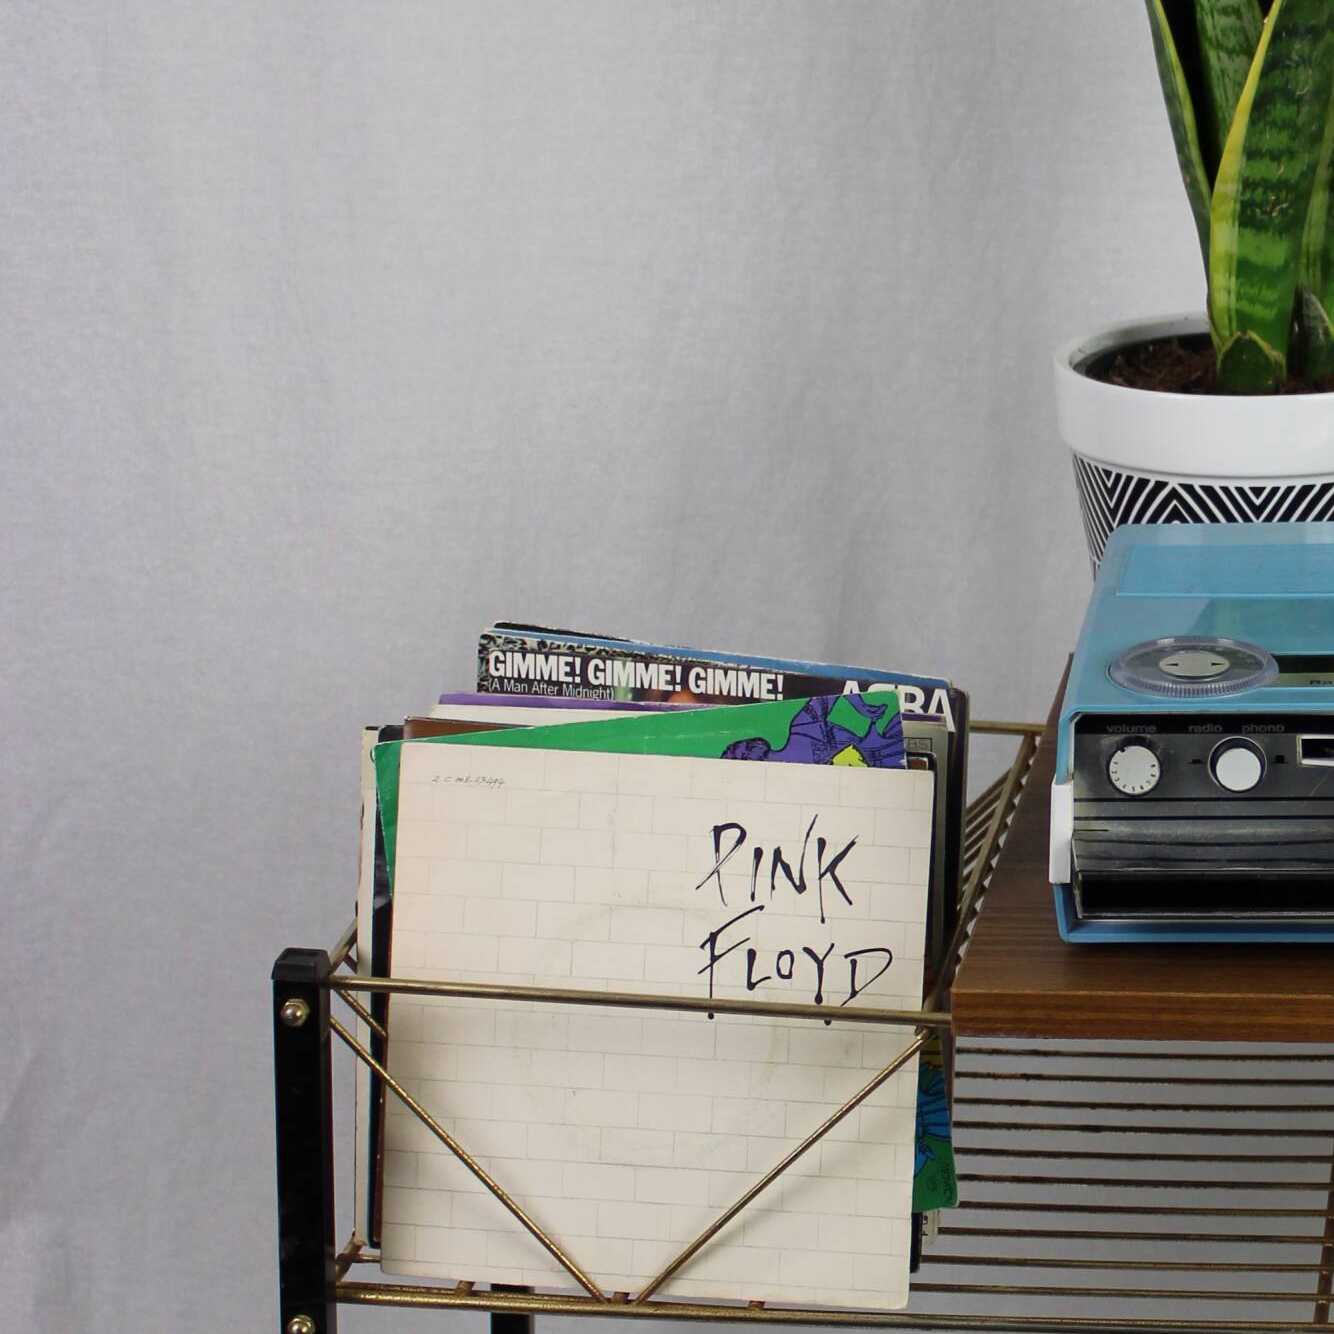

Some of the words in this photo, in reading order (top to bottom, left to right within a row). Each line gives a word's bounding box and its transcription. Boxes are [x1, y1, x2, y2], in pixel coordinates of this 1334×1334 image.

[488, 676, 501, 692] (A
[503, 680, 528, 693] Man
[532, 682, 559, 697] After
[562, 684, 615, 701] Midnight)
[489, 651, 581, 684] GIMME!
[588, 657, 681, 693] GIMME!
[688, 666, 785, 701] GIMME!
[841, 680, 957, 733] BA
[1106, 723, 1157, 734] volume
[1188, 723, 1224, 733] radio
[1241, 723, 1286, 735] phono
[695, 813, 860, 924] PINK
[697, 905, 893, 1024] FLOYD
